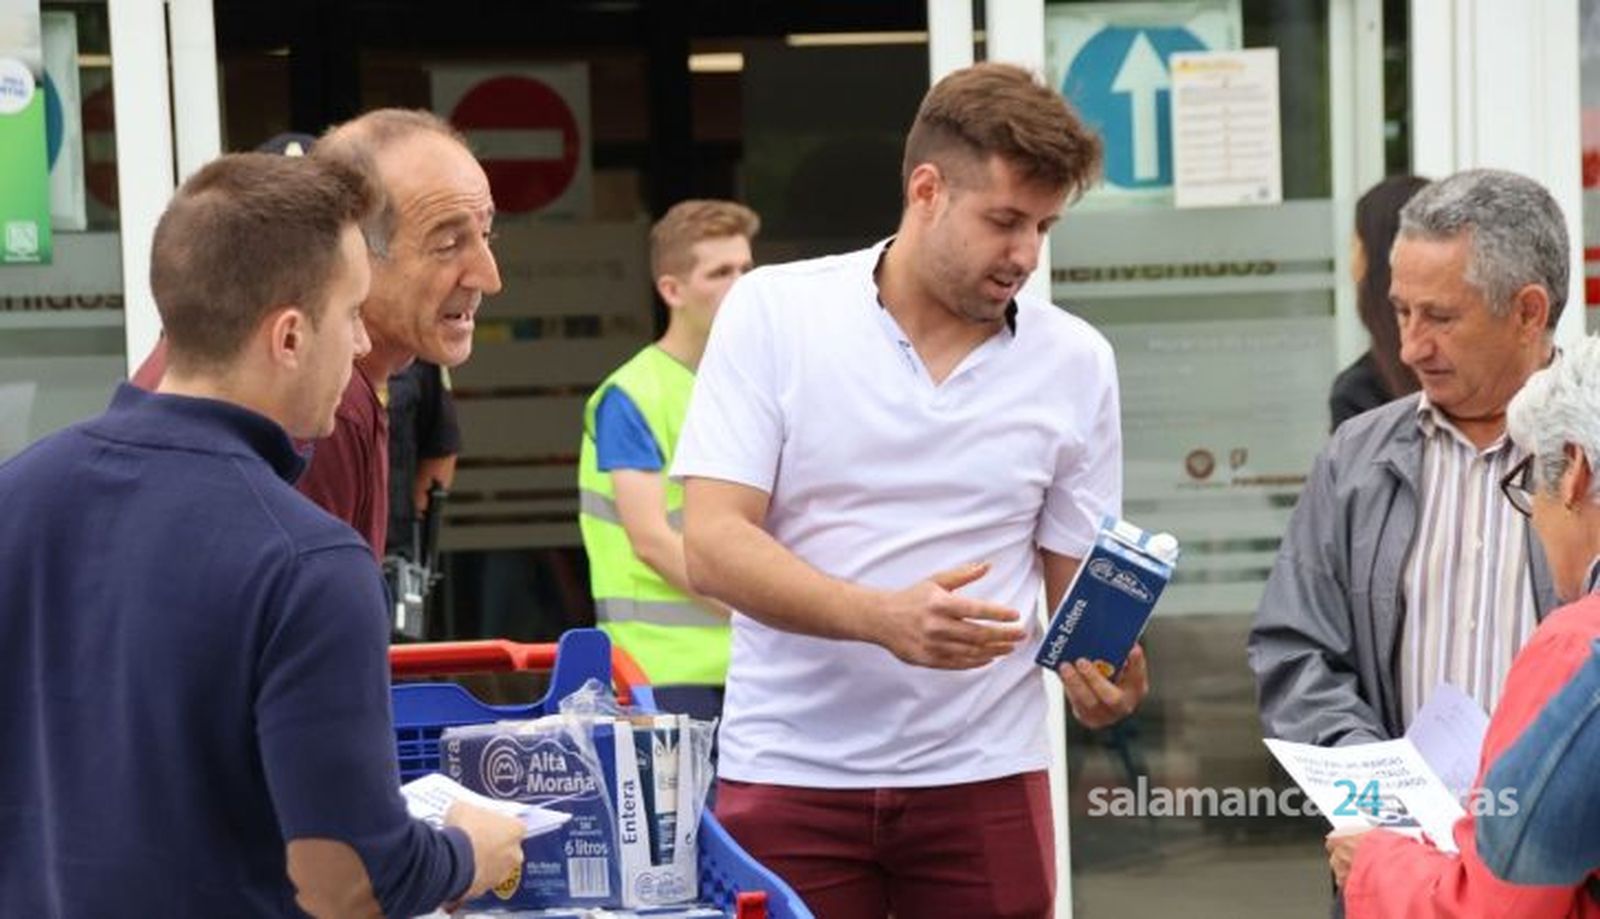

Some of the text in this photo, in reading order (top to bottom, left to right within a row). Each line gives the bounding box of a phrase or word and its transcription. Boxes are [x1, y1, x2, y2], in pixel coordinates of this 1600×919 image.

[1043, 599, 1087, 665] Leche Entera
[529, 750, 567, 772] Alta
[526, 771, 596, 793] Moraña
[621, 779, 637, 845] Entera
[564, 838, 608, 856] 6 litros
